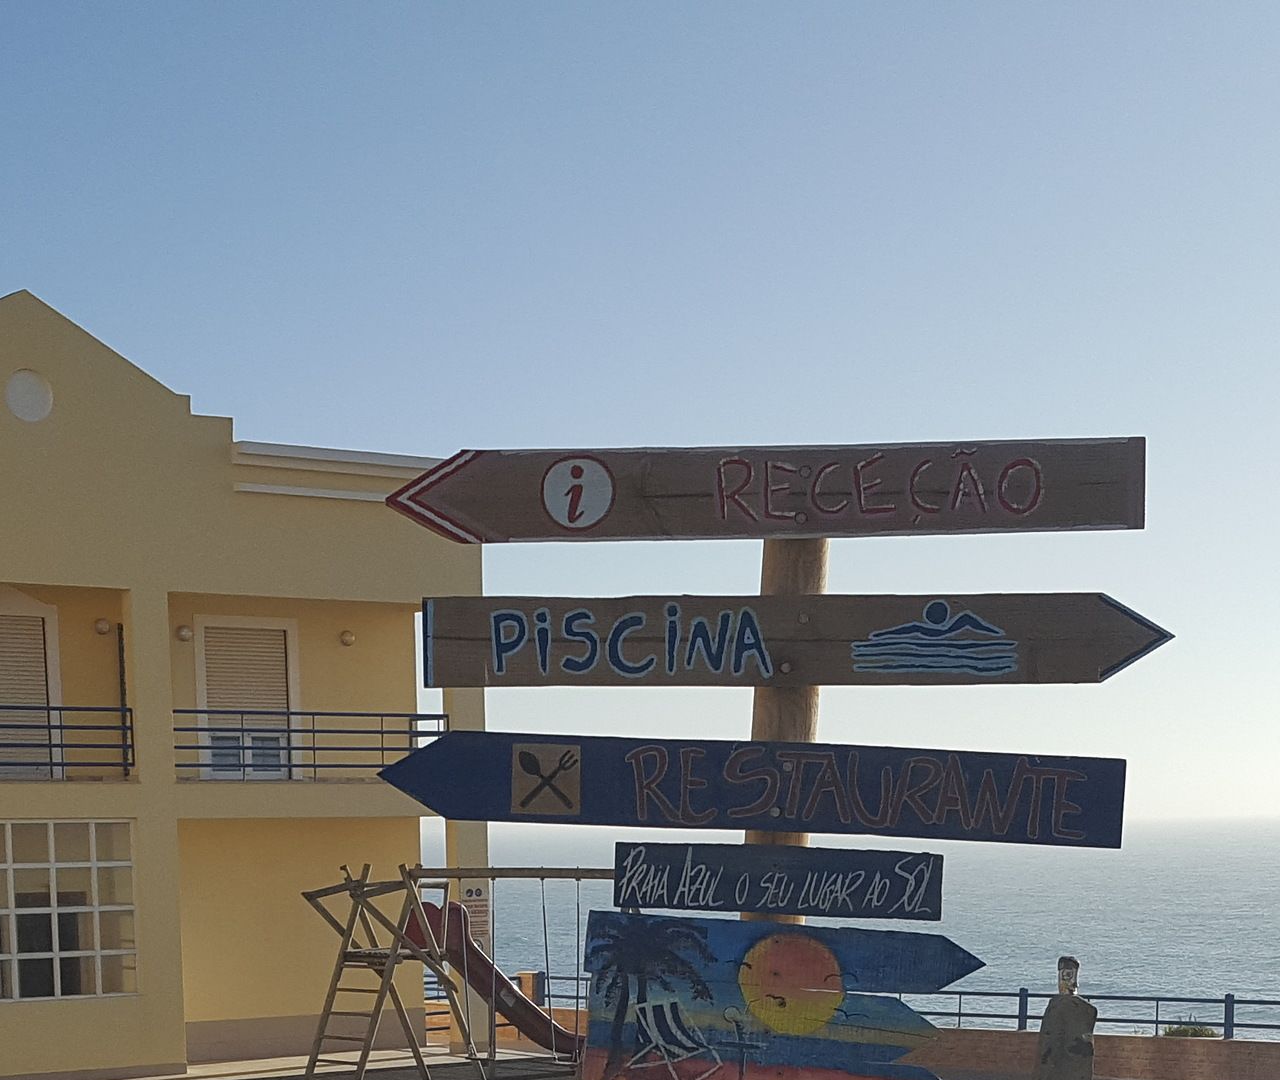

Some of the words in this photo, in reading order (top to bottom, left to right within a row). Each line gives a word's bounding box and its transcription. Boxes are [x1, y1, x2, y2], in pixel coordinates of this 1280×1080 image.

[716, 446, 1043, 525] RECEÇÃO
[624, 744, 1089, 841] RESTAURANTE
[673, 846, 724, 907] AZUL
[735, 872, 750, 905] O
[755, 871, 794, 909] SEU
[797, 870, 865, 913] LUGAR
[861, 870, 890, 909] AO
[886, 855, 934, 914] SOL
